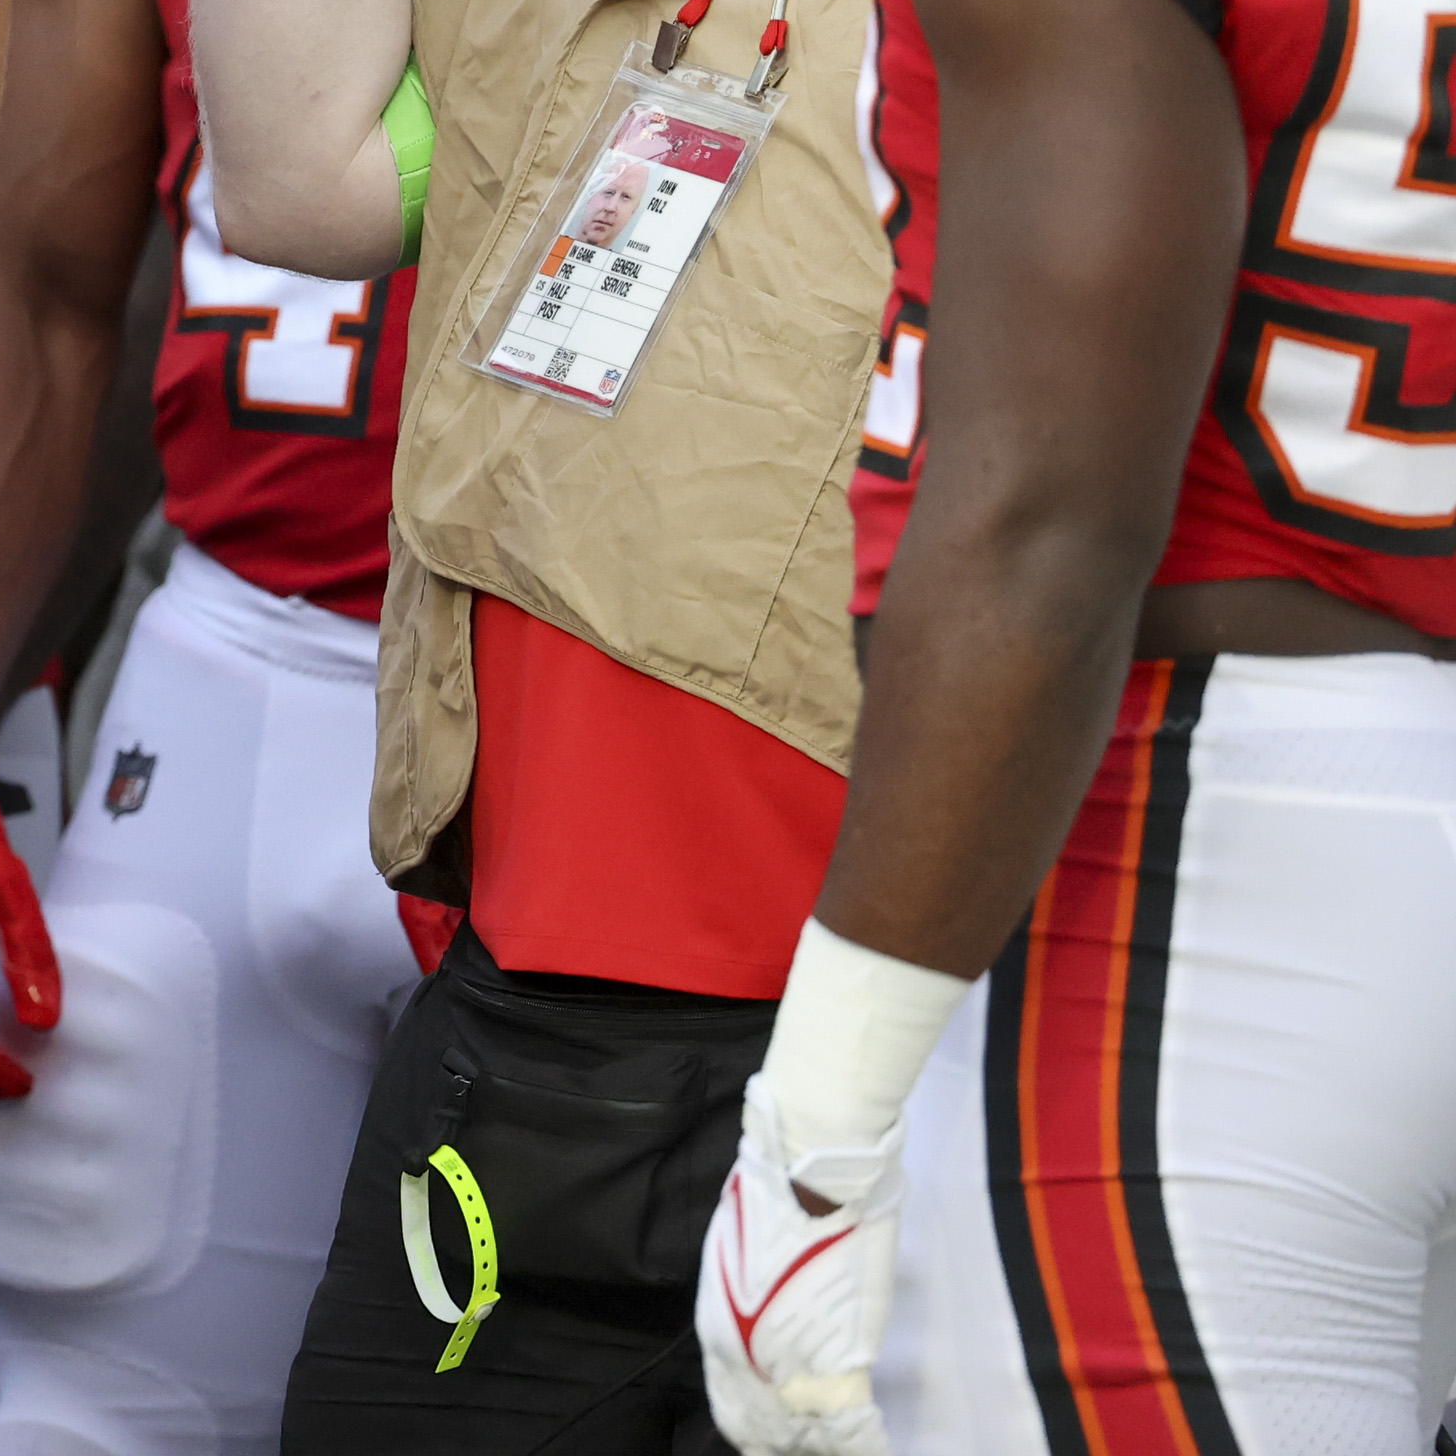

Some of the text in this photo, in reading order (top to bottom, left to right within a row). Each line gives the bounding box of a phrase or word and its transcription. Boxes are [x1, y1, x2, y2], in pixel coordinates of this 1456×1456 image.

[657, 179, 678, 196] JOHN
[647, 197, 668, 214] FOLZ
[568, 245, 596, 264] IN GAME
[558, 263, 575, 280] PRE
[611, 257, 642, 279] GENERAL
[547, 282, 570, 300] HALF
[601, 275, 632, 297] SERVICE
[537, 300, 561, 320] POST
